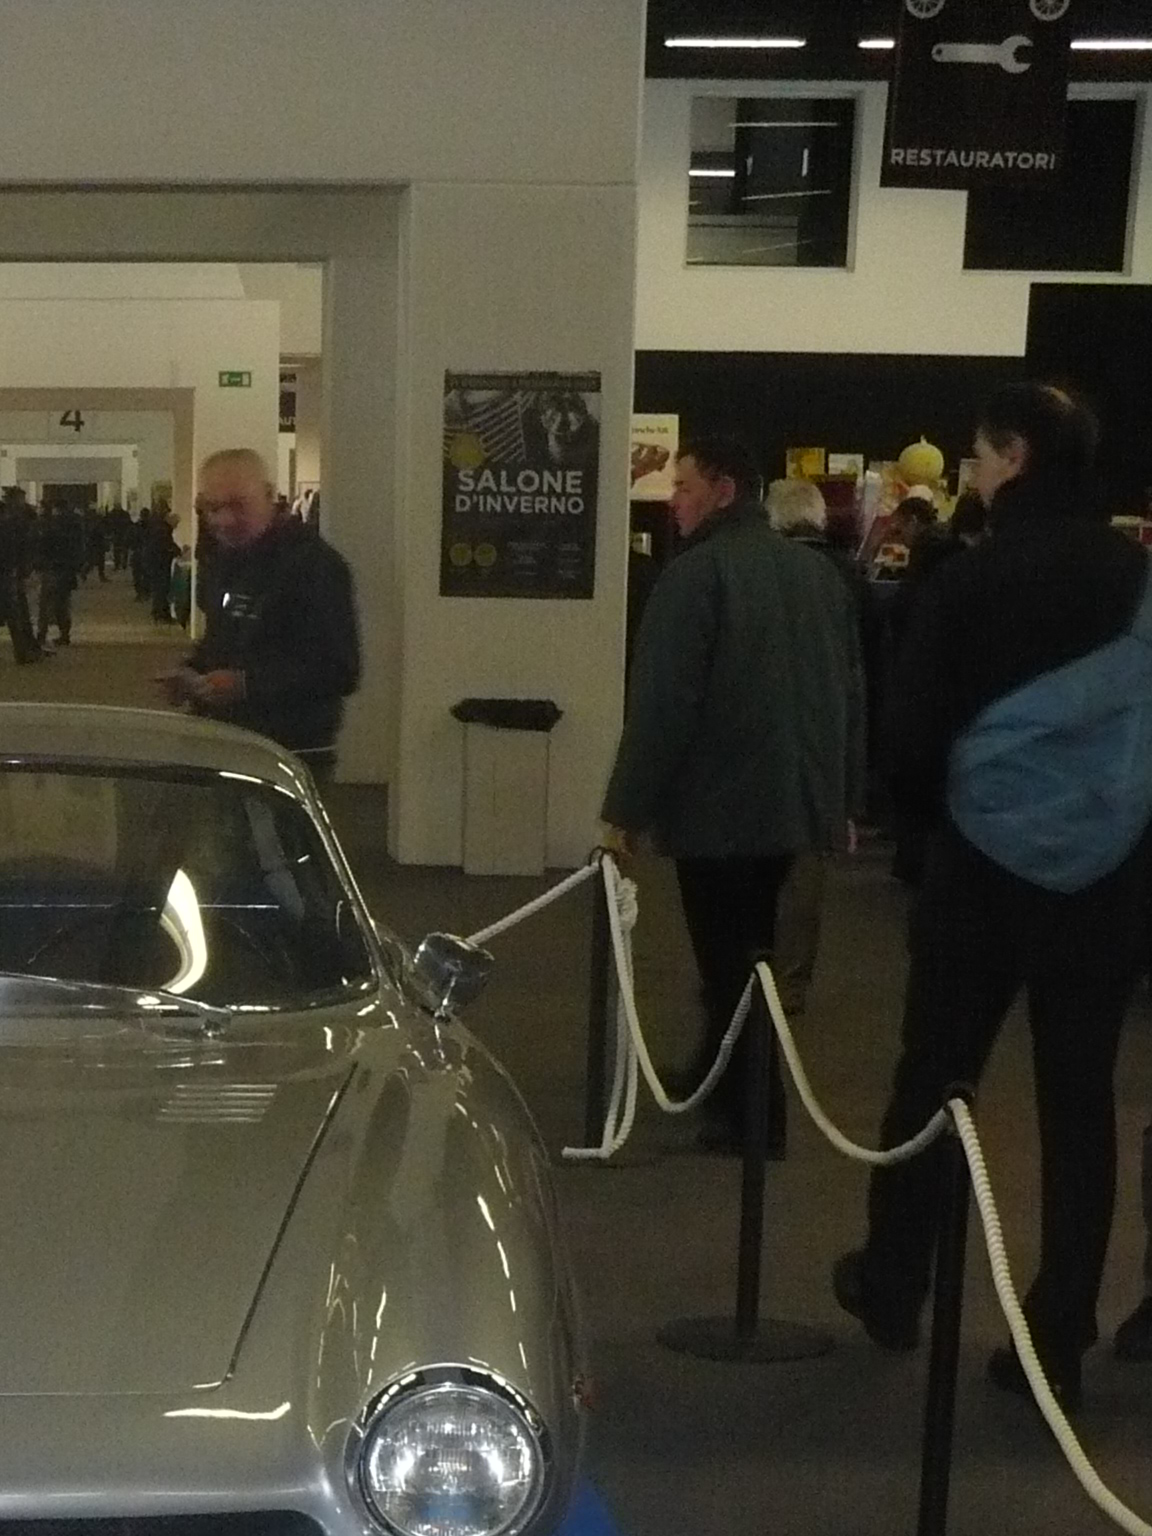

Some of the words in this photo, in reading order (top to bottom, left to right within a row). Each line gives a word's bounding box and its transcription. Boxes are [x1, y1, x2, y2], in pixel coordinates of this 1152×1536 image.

[890, 149, 1056, 169] RESTAURATORI
[59, 409, 85, 432] 4
[457, 469, 584, 495] SALONE
[454, 495, 586, 515] D'INVERNO
